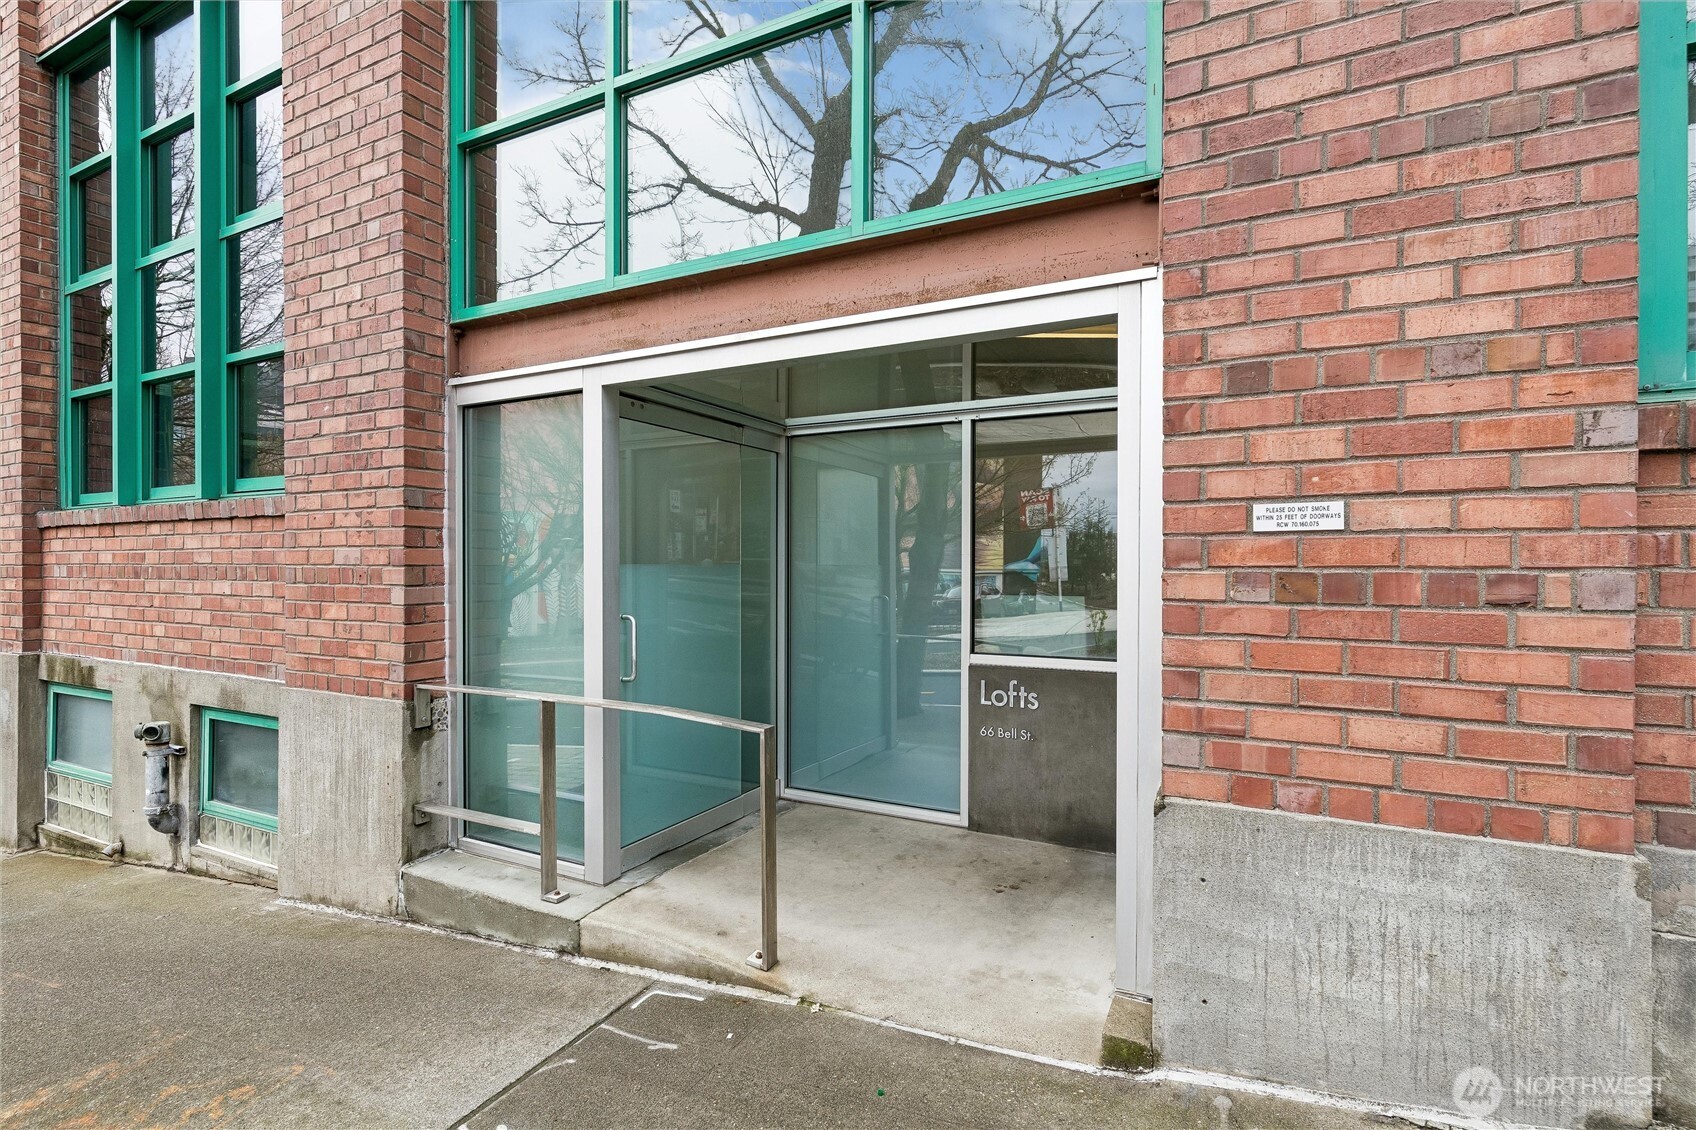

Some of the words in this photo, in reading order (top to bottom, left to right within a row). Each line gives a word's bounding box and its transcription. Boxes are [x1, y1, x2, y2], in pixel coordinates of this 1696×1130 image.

[980, 679, 1039, 710] Lofts
[979, 726, 995, 737] 66
[997, 727, 1017, 739] Bell
[1020, 729, 1034, 741] St.
